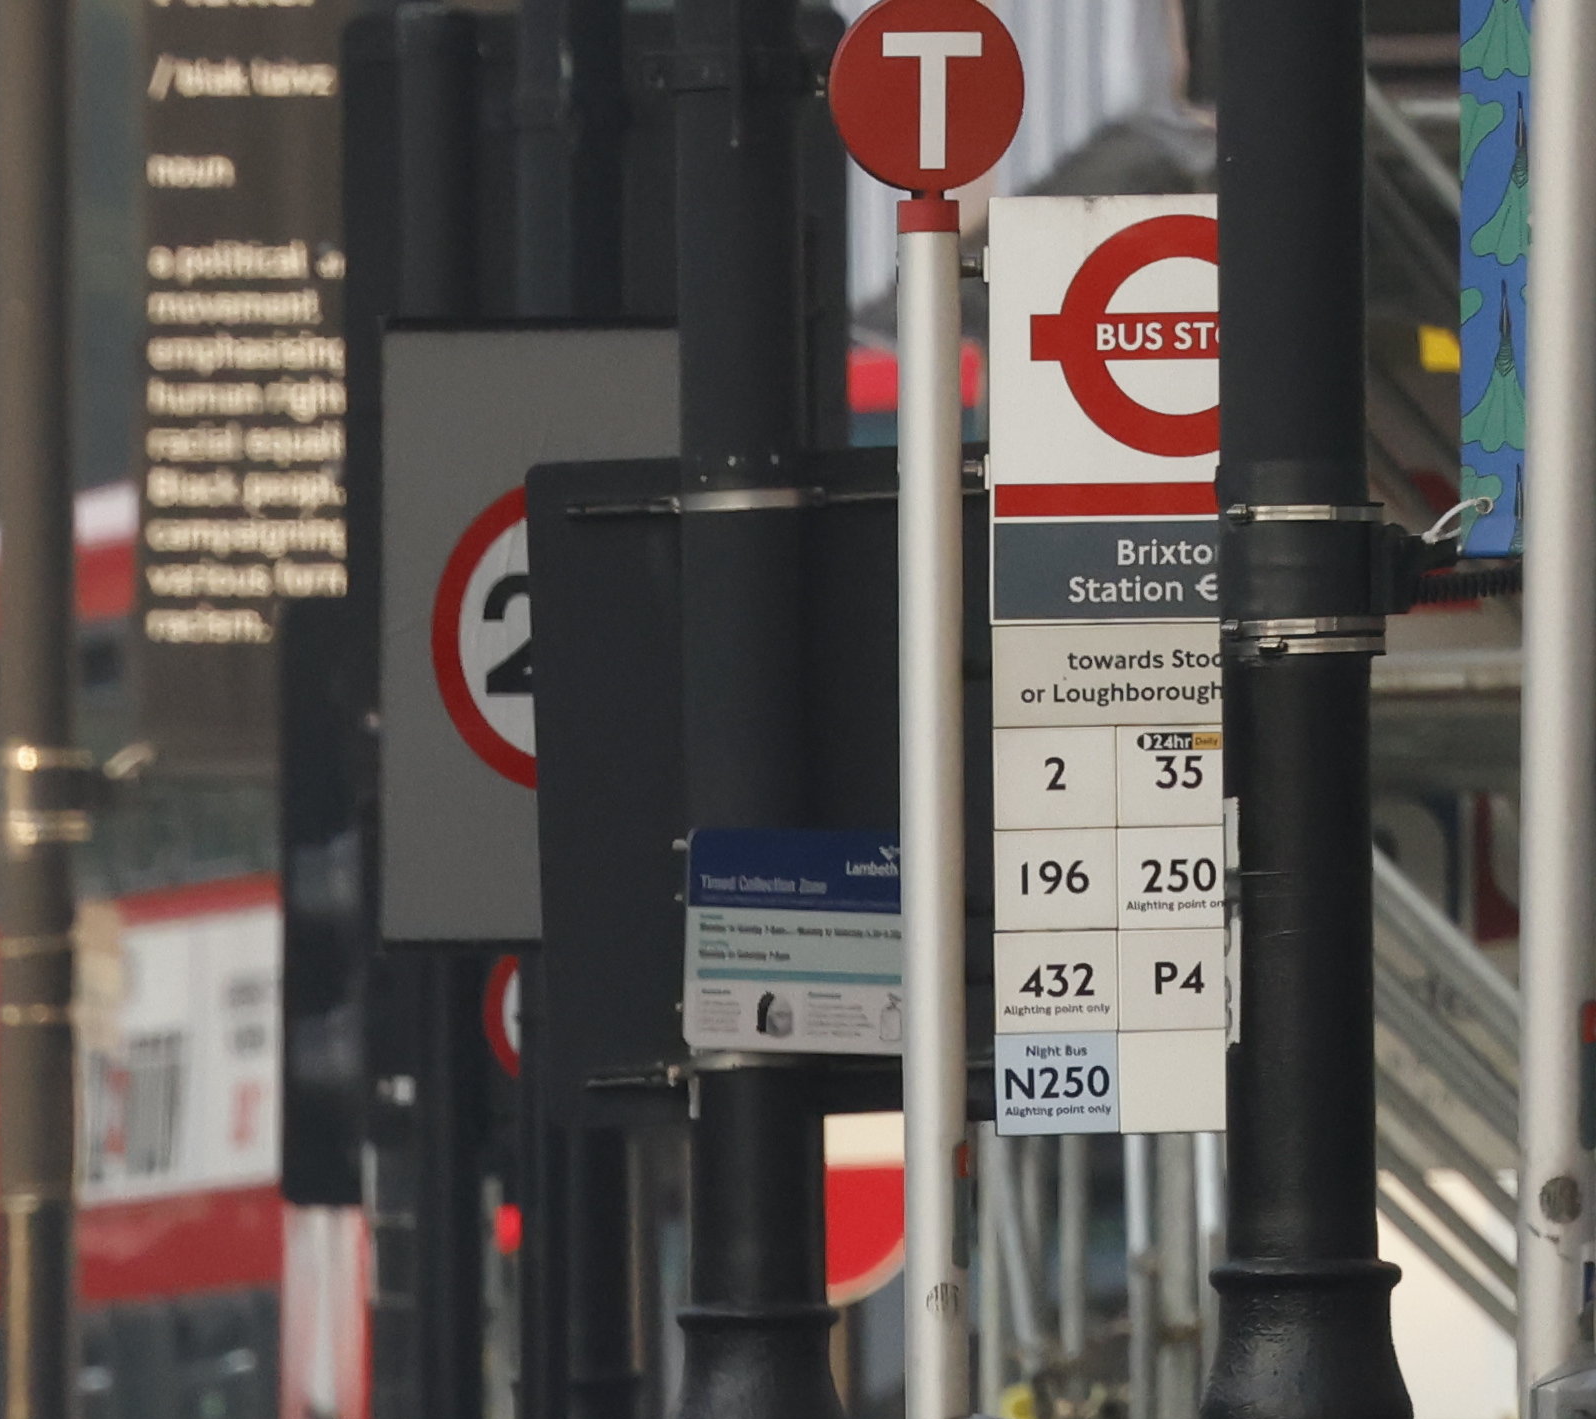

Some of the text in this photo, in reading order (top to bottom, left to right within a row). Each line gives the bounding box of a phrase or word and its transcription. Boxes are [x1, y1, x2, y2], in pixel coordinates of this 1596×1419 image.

[882, 32, 983, 170] T
[175, 239, 309, 285] political
[1095, 321, 1219, 351] BUS ST
[146, 377, 264, 417] human
[1117, 538, 1218, 566] Brixto
[1068, 575, 1184, 603] Station
[482, 573, 533, 694] 2
[1067, 649, 1222, 670] towards Stoc
[1020, 687, 1045, 703] or
[1153, 733, 1192, 750] 24hr
[1044, 757, 1067, 791] 2
[1155, 755, 1204, 789] 35
[845, 860, 899, 877] Lambeth
[1021, 860, 1090, 895] 196
[1141, 858, 1217, 893] 250
[1126, 901, 1175, 912] Alighting
[1177, 899, 1207, 910] point
[1019, 962, 1095, 998] 432
[1154, 961, 1205, 995] P4
[1003, 1003, 1111, 1017] Alighting point only
[1025, 1044, 1088, 1059] Night Bus
[1004, 1065, 1110, 1100] N250
[1005, 1103, 1112, 1118] Alighting point only
